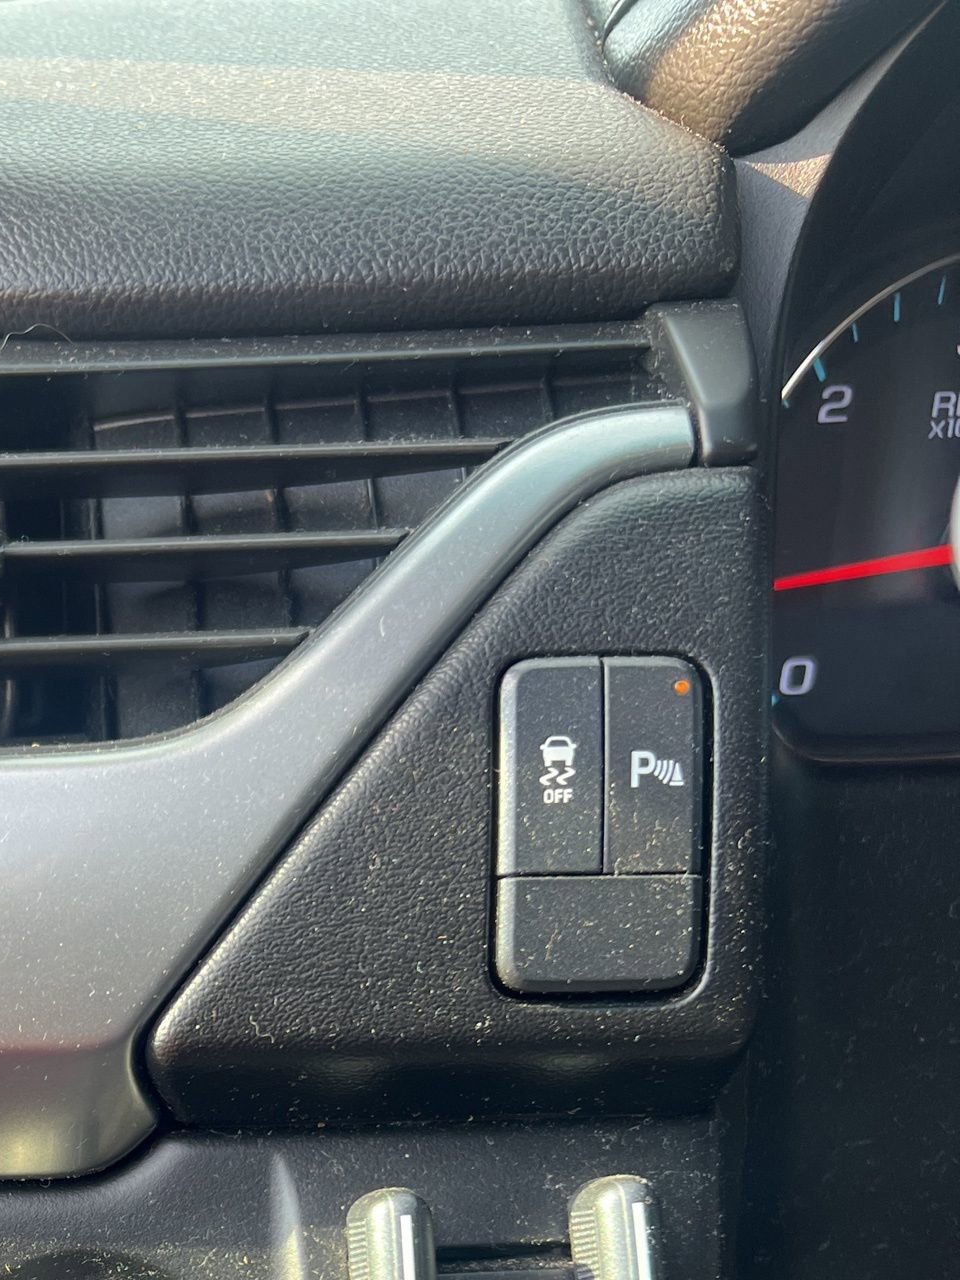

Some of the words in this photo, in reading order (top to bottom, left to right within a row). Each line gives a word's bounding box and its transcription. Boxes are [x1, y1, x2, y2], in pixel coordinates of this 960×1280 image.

[817, 384, 853, 424] 2
[931, 391, 960, 418] R
[779, 657, 817, 696] 0
[543, 788, 573, 804] OFF
